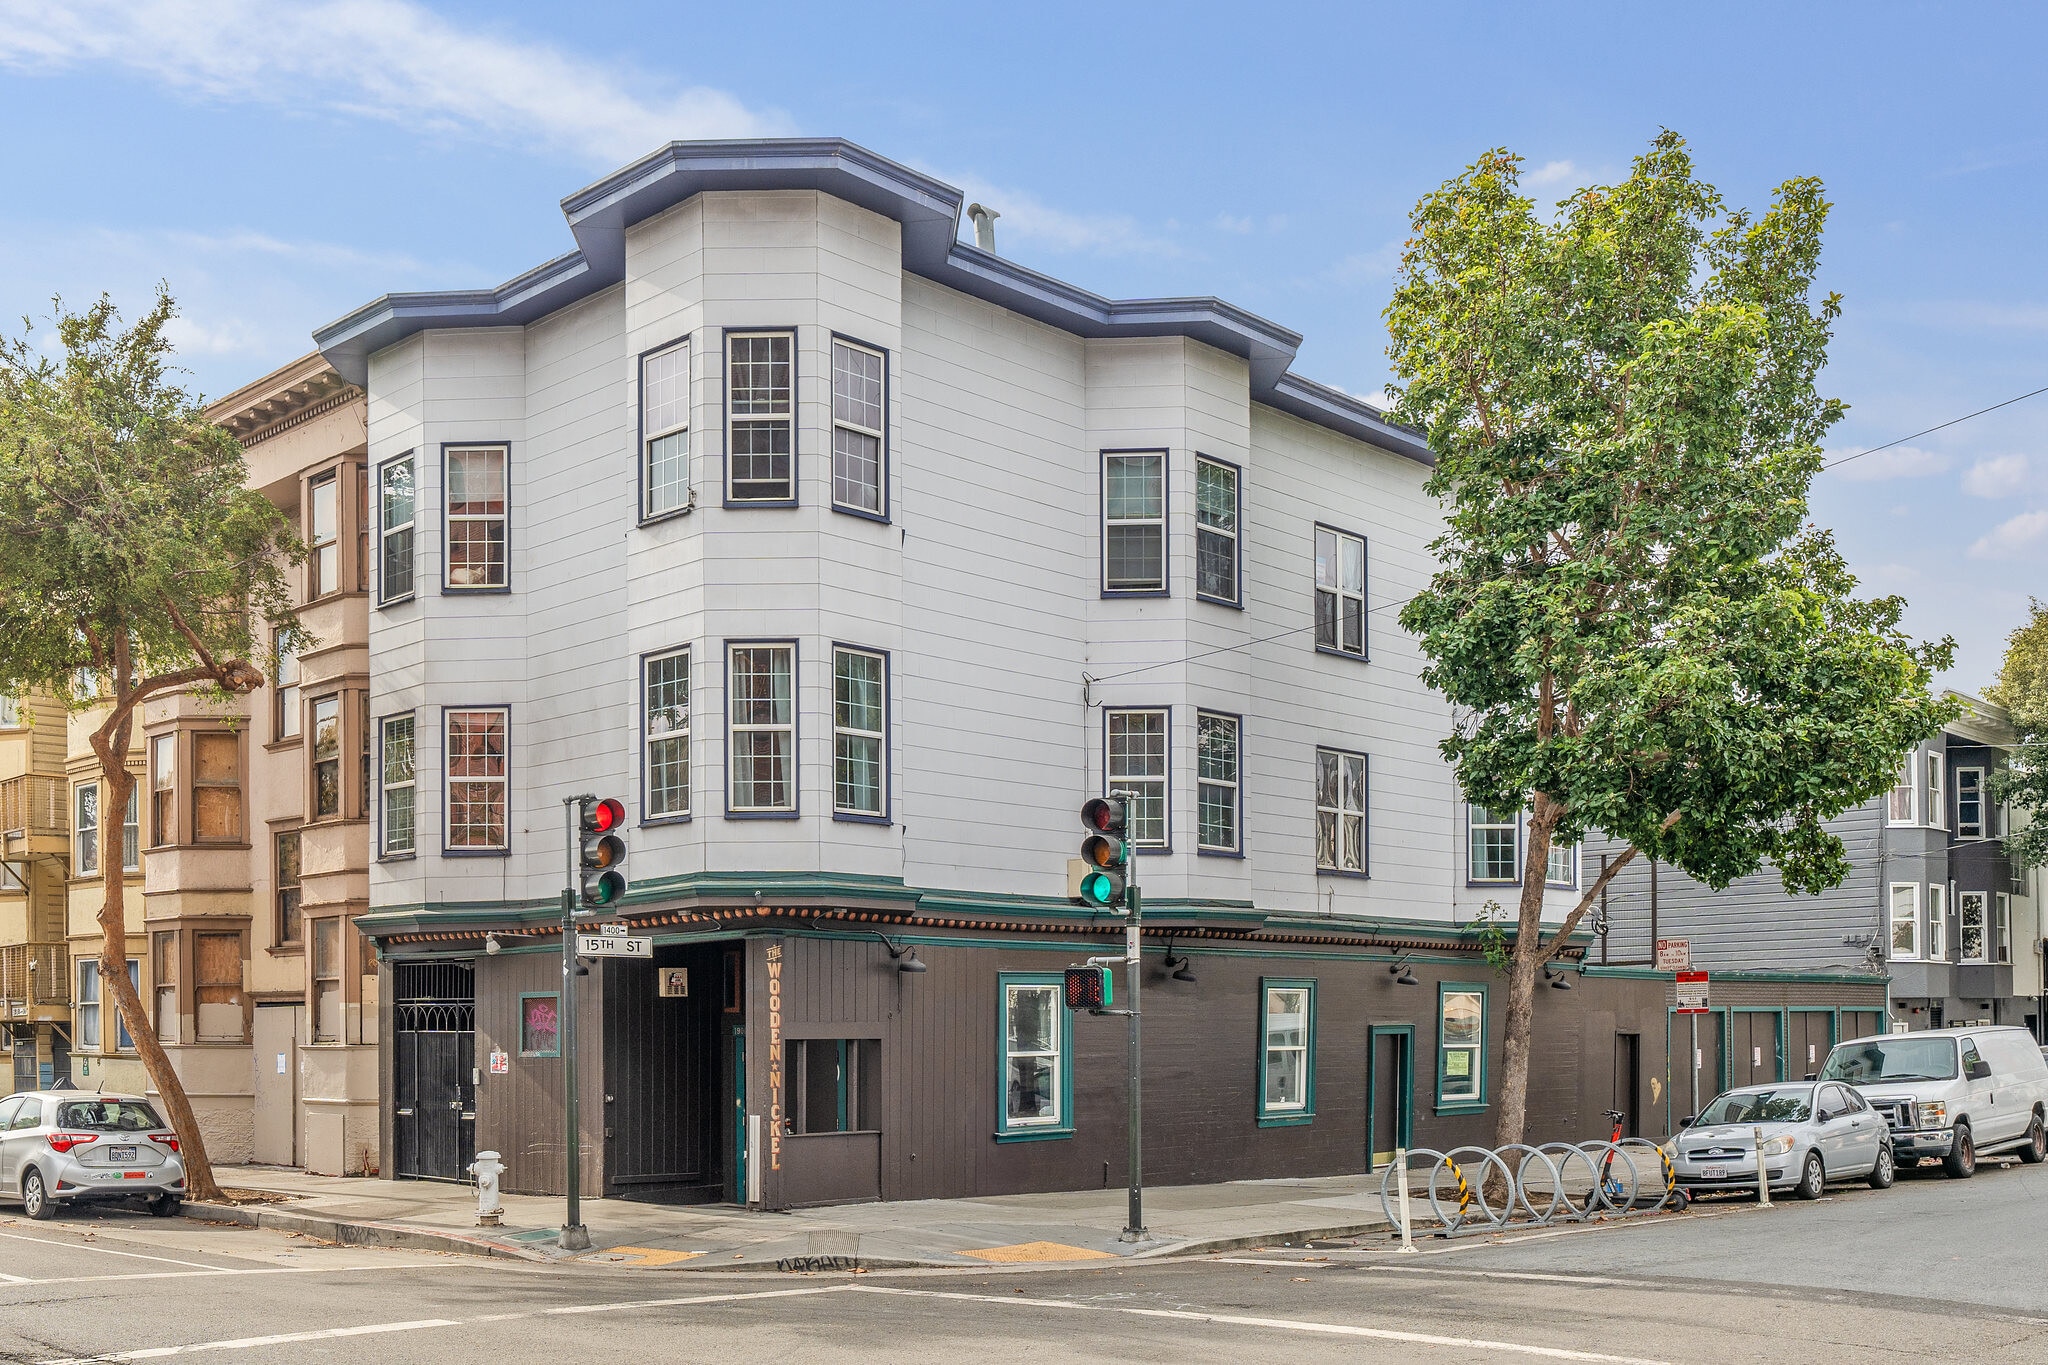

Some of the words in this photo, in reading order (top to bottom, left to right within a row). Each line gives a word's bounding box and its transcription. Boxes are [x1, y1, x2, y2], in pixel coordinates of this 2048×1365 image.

[604, 926, 620, 935] 1400
[586, 939, 614, 950] 15TH
[626, 941, 642, 952] ST
[1658, 941, 1667, 950] NO
[766, 962, 782, 1062] WOODEN
[769, 1071, 781, 1171] NICKEL
